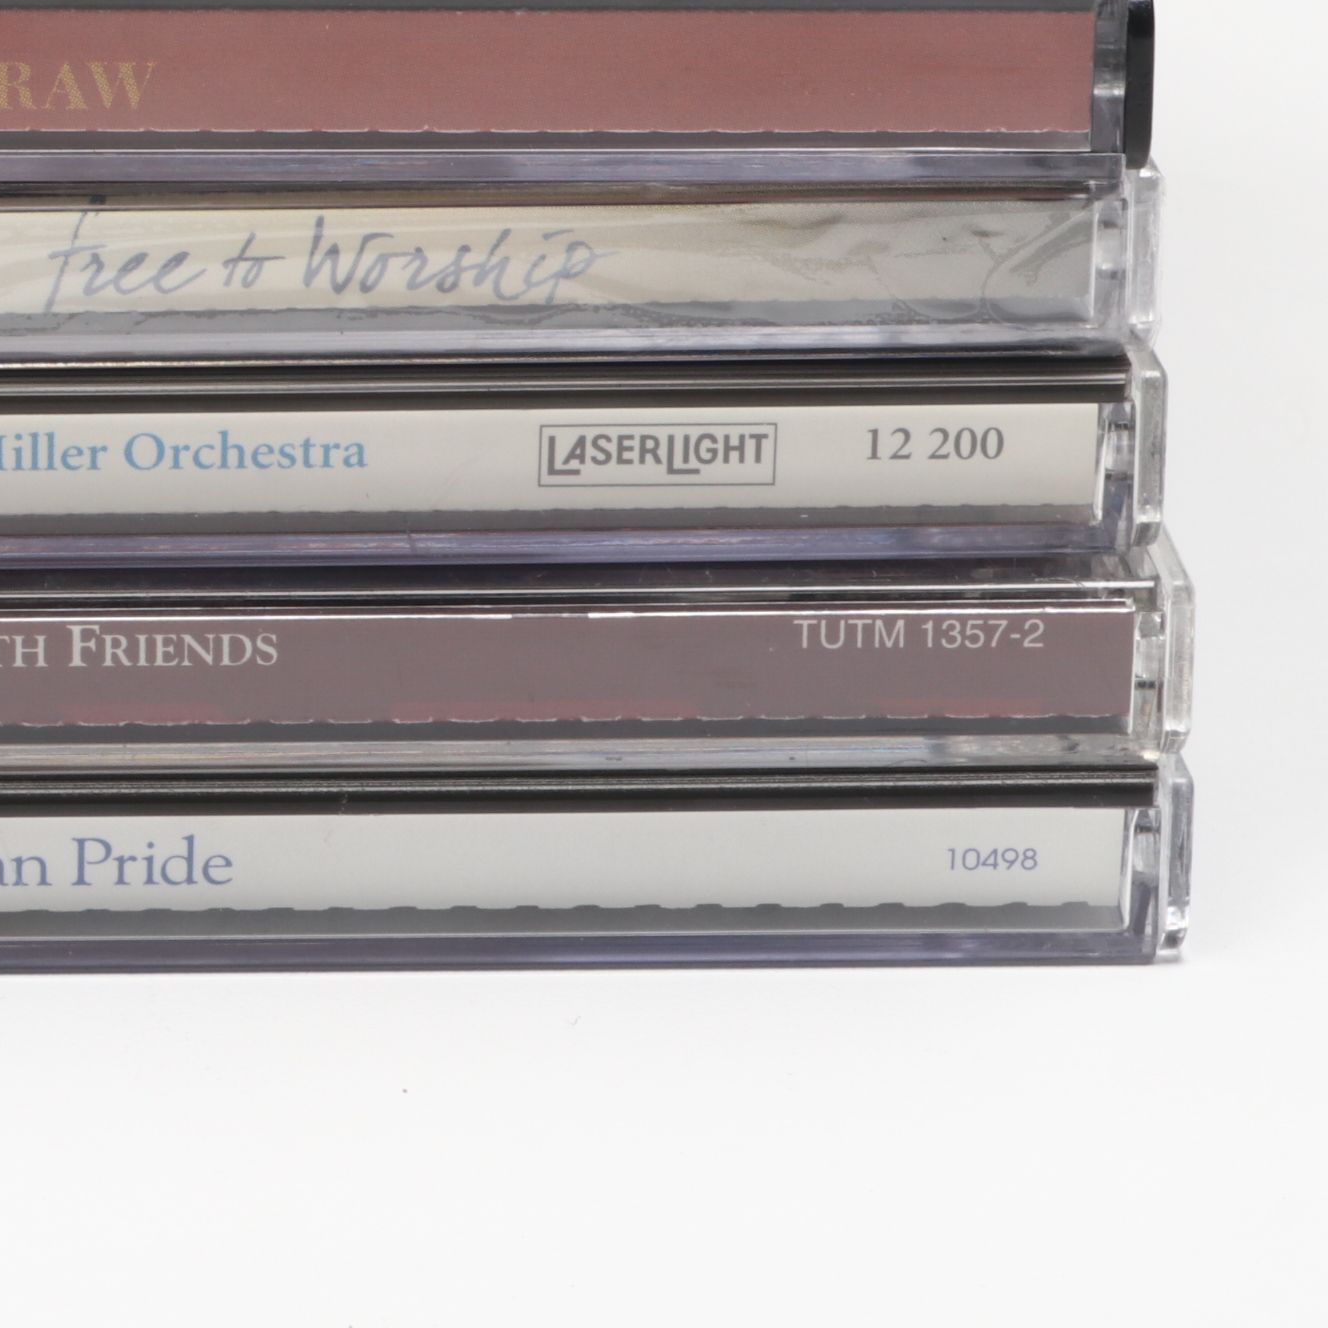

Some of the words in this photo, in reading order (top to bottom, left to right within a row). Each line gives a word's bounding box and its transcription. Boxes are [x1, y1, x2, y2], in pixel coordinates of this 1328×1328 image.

[223, 232, 285, 289] to
[302, 215, 612, 306] Worship
[123, 431, 368, 472] Orchestra
[867, 427, 912, 462] 12
[928, 427, 1005, 462] 200
[68, 624, 280, 668] FRIENDS
[793, 620, 905, 649] TUTM
[921, 619, 1045, 649] 1357-2
[71, 835, 235, 887] Pride
[947, 848, 1039, 871] 10498
